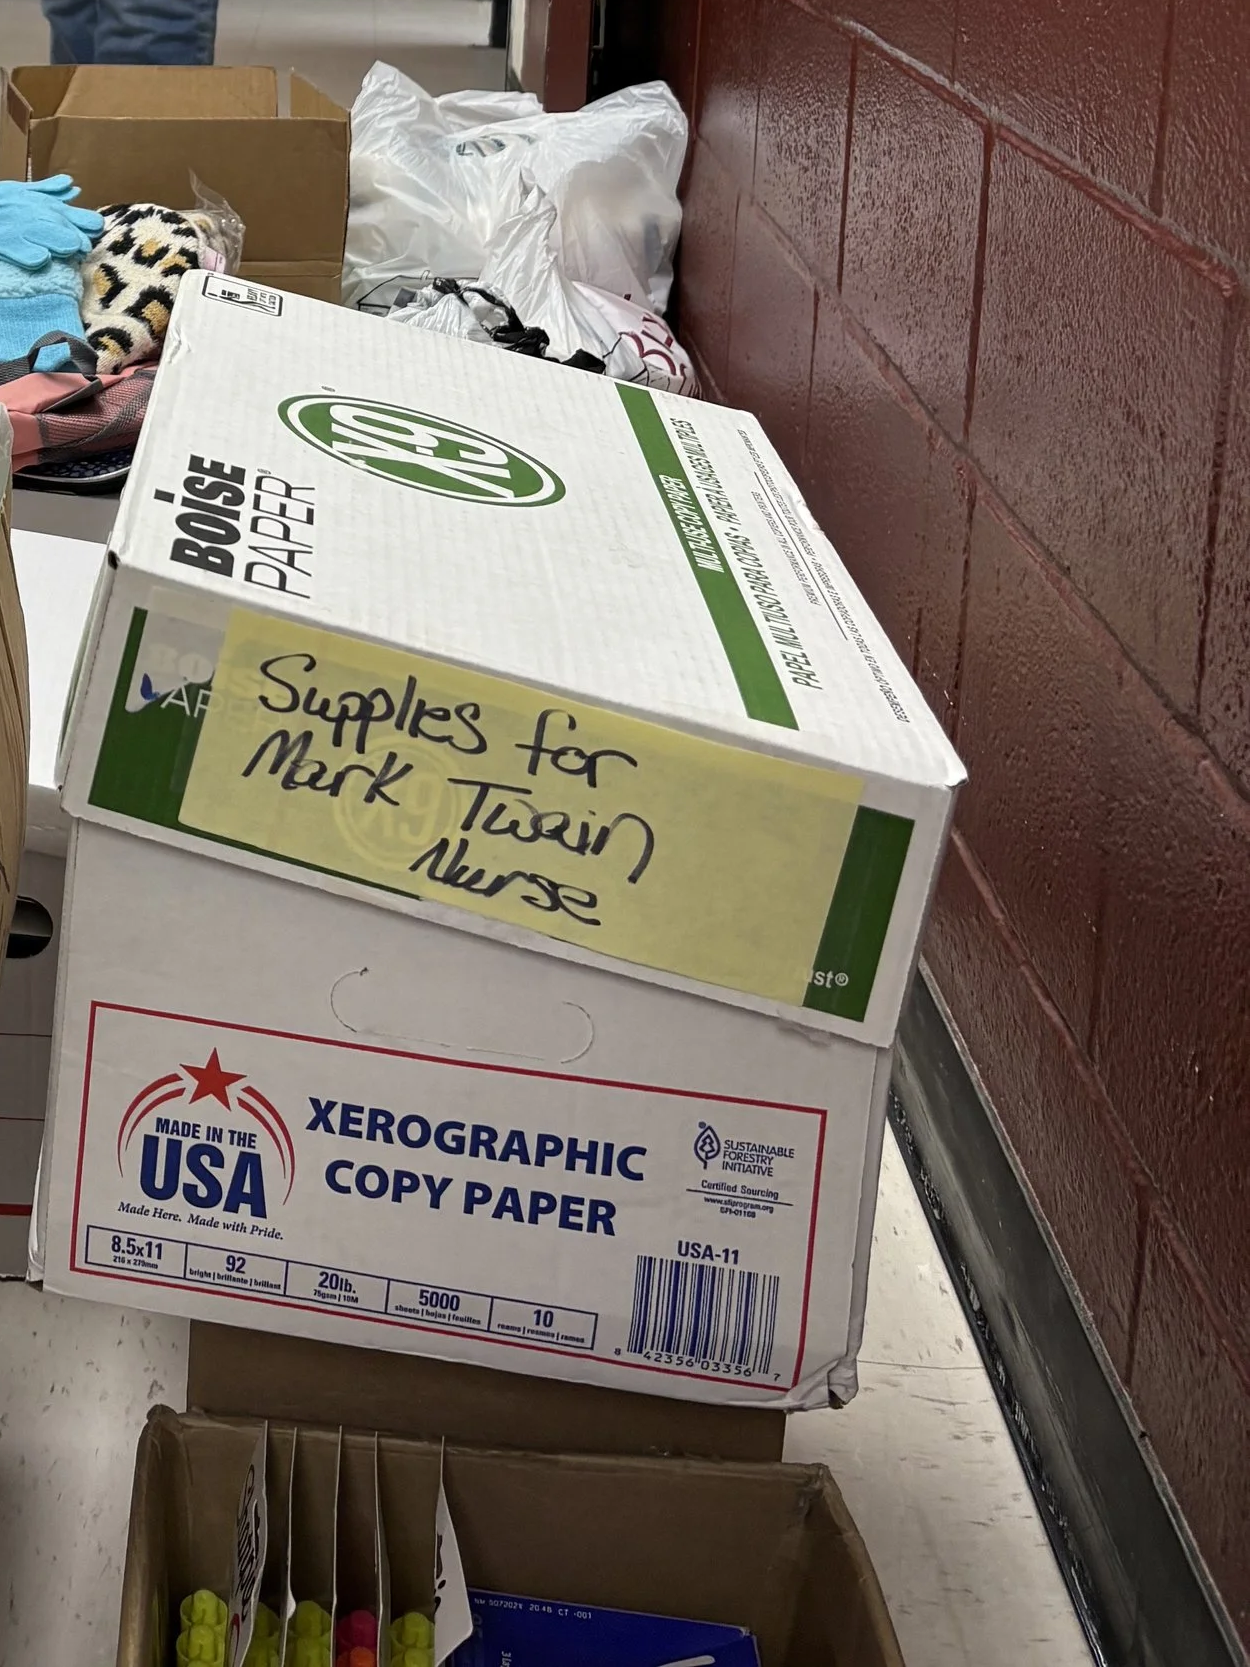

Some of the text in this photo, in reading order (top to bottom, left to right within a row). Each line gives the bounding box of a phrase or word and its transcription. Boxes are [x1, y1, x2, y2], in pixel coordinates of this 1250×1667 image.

[154, 453, 246, 578] BOISE
[724, 532, 764, 569] COPIAS
[740, 566, 778, 597] PARA
[753, 593, 804, 650] MULTIUSO
[779, 649, 823, 690] PAPEL
[258, 653, 488, 755] Supplies
[516, 709, 638, 788] for
[241, 730, 655, 885] Mark Twain
[409, 837, 602, 926] Nurse
[155, 1117, 258, 1149] MADE IN THE
[305, 1096, 648, 1182] XEROGRAPHIC
[723, 1139, 796, 1159] SUSTAINABLE
[721, 1161, 774, 1177] INITIATIVE
[722, 1151, 775, 1166] FORESTRY
[140, 1134, 267, 1220] USA
[701, 1180, 779, 1199] Certified Sourcing
[324, 1159, 618, 1236] COPY PAPER
[118, 1201, 284, 1240] Made Here. Made with Pride.
[111, 1235, 164, 1260] 8.5x11
[677, 1240, 740, 1265] USA-11
[225, 1255, 247, 1274] 92
[318, 1271, 358, 1295] 20lb.
[418, 1288, 461, 1312] 5000
[533, 1309, 554, 1328] 10
[614, 1347, 781, 1382] 8 42356 03356 7
